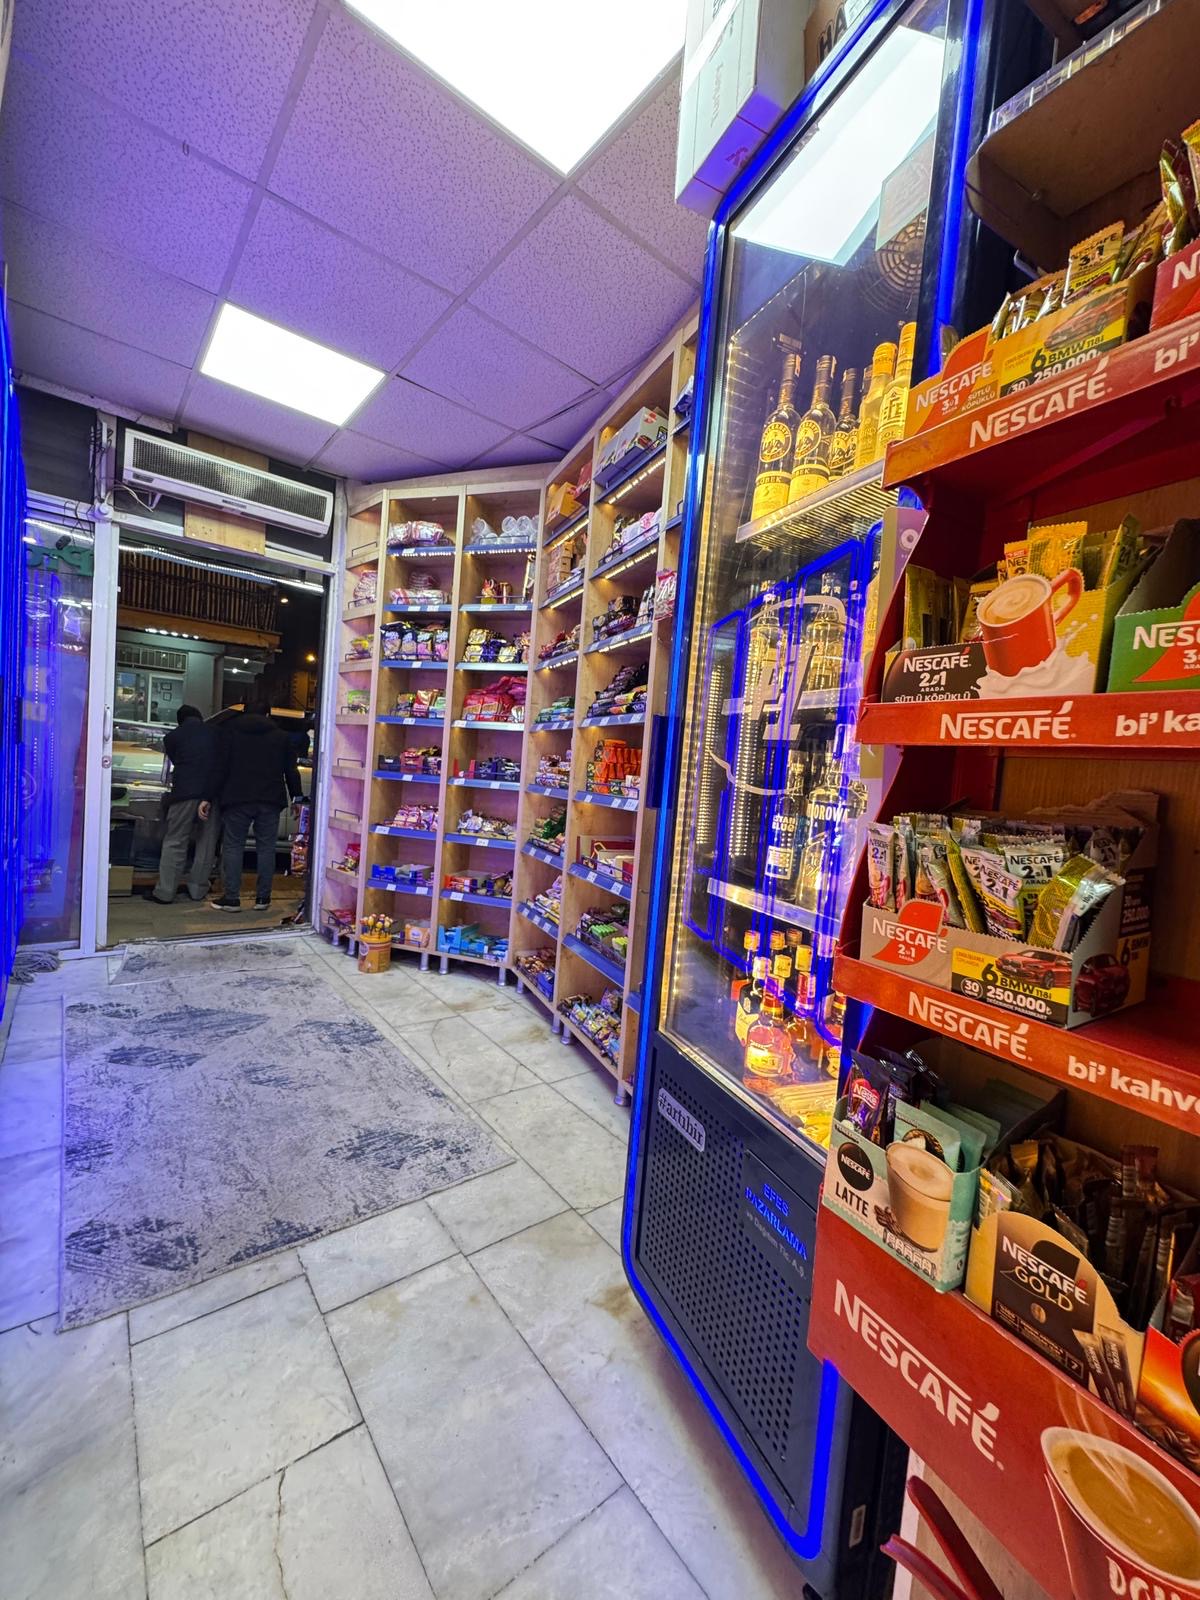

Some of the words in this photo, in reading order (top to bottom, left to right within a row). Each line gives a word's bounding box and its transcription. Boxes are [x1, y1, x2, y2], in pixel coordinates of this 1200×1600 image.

[1047, 340, 1086, 365] BMW
[969, 356, 1113, 449] NESCAFÉ
[1132, 621, 1200, 650] NES
[903, 646, 972, 673] NESCAFÉ
[939, 700, 1077, 739] NESCAFÉ
[964, 979, 980, 993] 30
[981, 963, 999, 986] 6
[1000, 976, 1035, 995] BMW
[1036, 987, 1052, 1000] 118i
[908, 992, 1033, 1062] NESCAFÉ
[763, 1183, 790, 1217] EFES
[835, 1181, 869, 1218] LATTE
[745, 1186, 808, 1261] PAZARLAMA
[1014, 1264, 1074, 1312] GOLD
[834, 1278, 1005, 1471] NESCAFÉ
